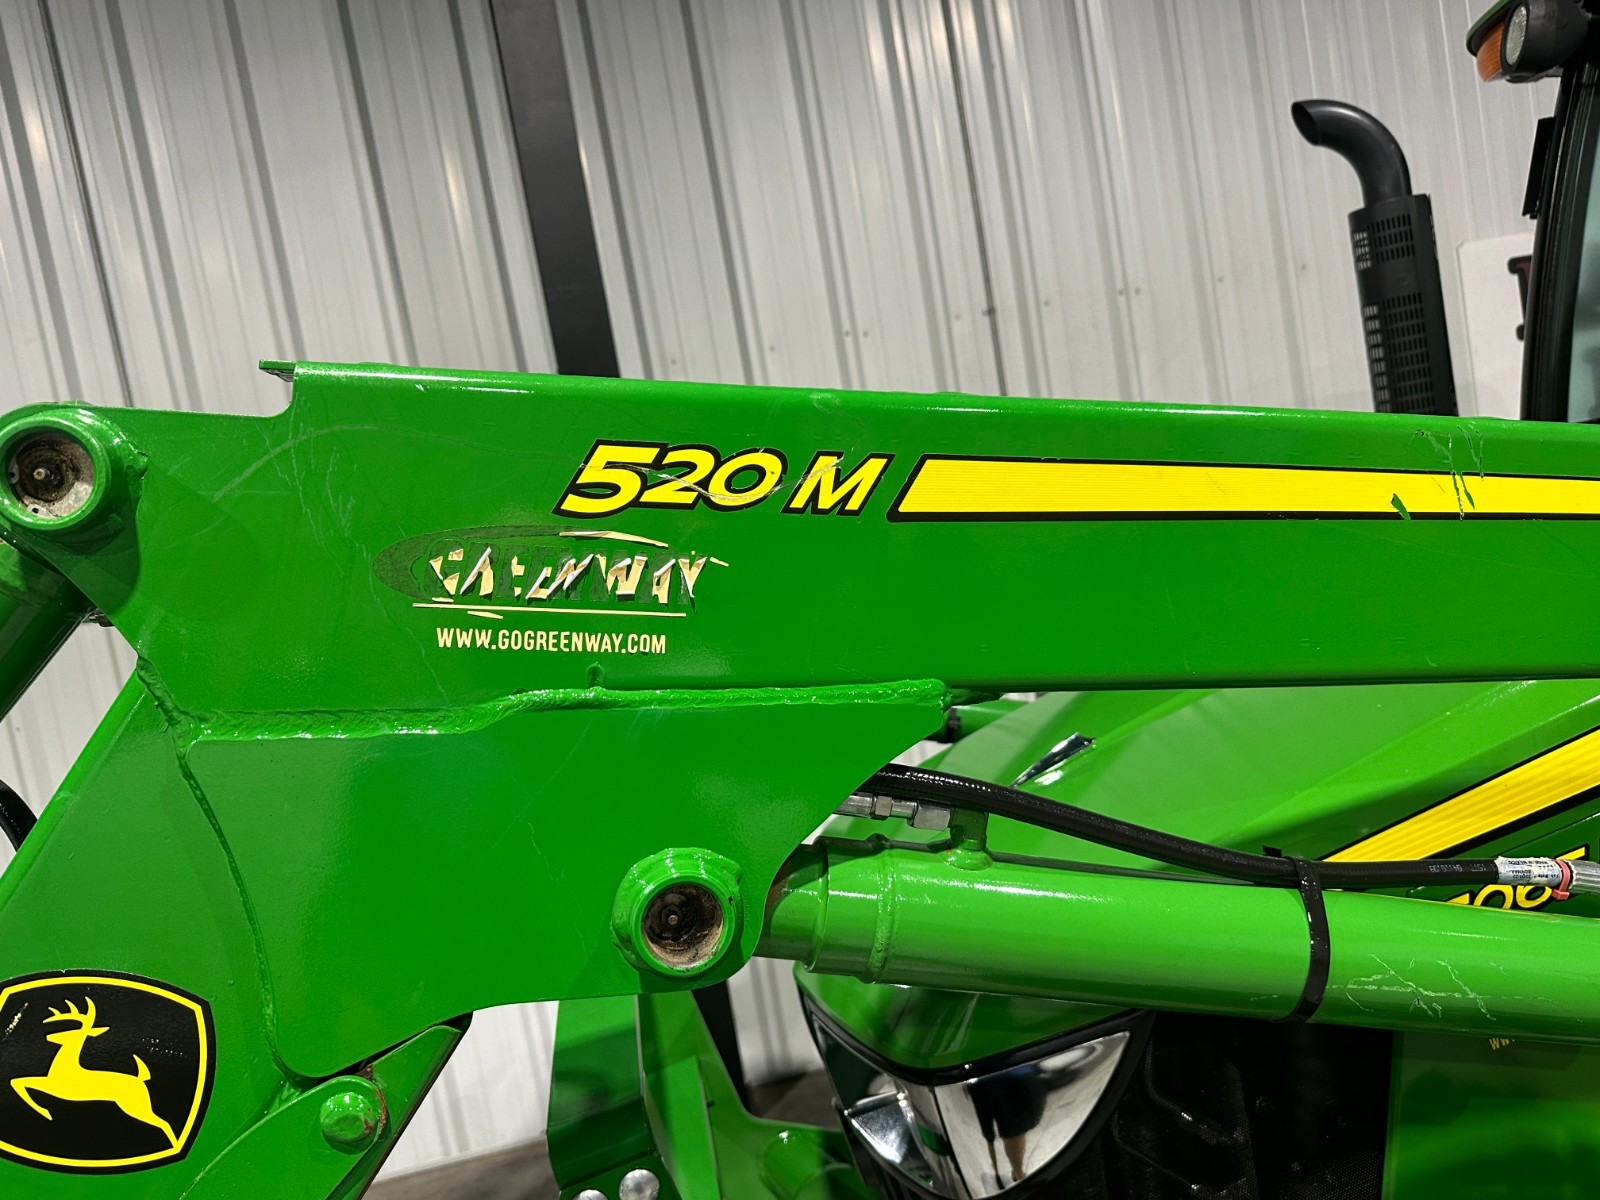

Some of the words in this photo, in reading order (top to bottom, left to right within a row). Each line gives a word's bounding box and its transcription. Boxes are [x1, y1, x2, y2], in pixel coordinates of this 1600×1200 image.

[554, 440, 787, 517] 520
[783, 451, 894, 516] M
[436, 627, 667, 654] WWW.GOGREENWAY.COM
